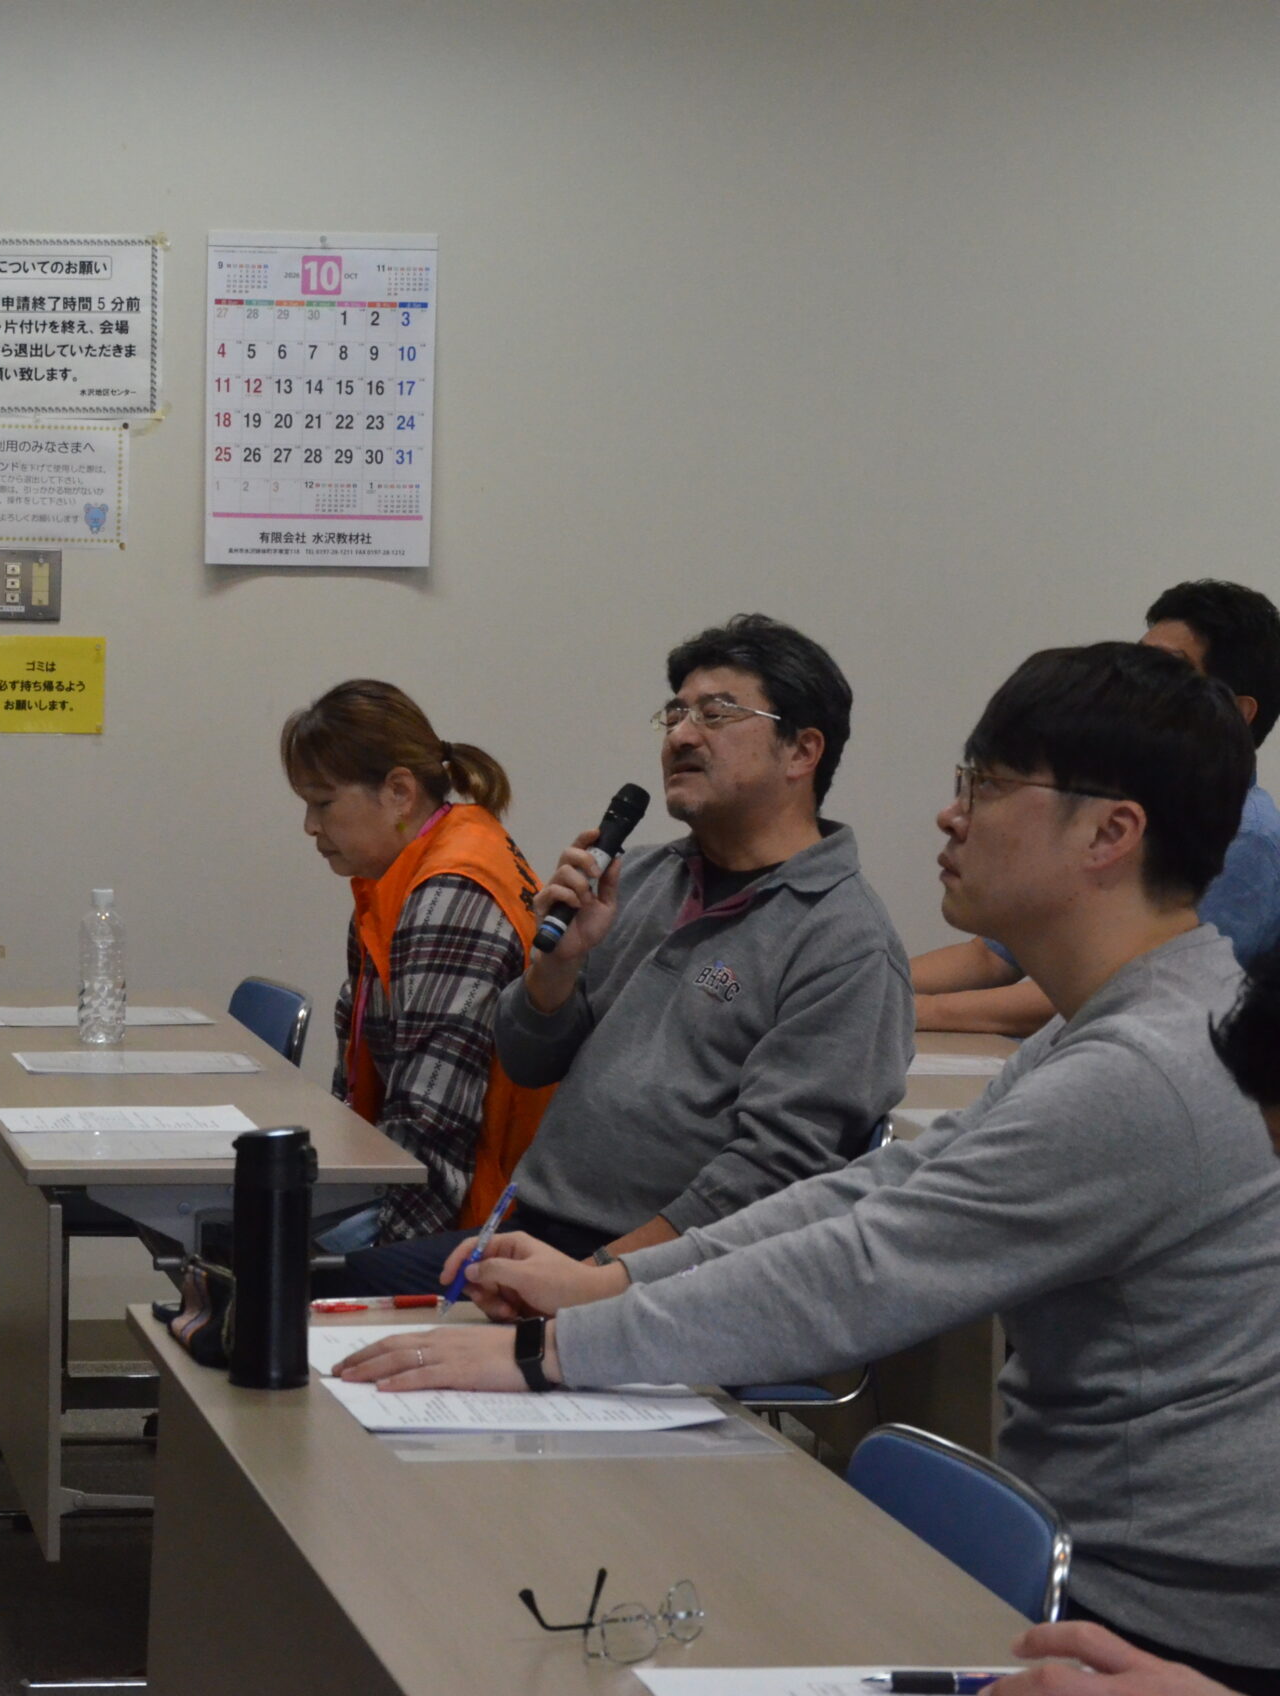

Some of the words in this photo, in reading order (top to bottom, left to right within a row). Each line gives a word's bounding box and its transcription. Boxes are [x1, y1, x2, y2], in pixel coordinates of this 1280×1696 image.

[218, 261, 223, 269] 9
[304, 260, 338, 292] 10
[344, 272, 358, 280] OCT
[216, 307, 229, 319] 27
[246, 308, 259, 319] 28
[277, 308, 290, 320] 29
[308, 309, 320, 320] 30
[341, 311, 346, 325] 1
[371, 311, 379, 326] 2
[402, 312, 410, 326] 3
[217, 343, 226, 357] 4
[248, 344, 256, 359] 5
[278, 344, 287, 359] 6
[309, 345, 317, 359] 7
[339, 345, 348, 360] 8
[370, 346, 379, 361] 9
[399, 346, 416, 361] 10
[216, 378, 230, 392] 11
[245, 378, 262, 393] 12
[275, 379, 292, 394] 13
[306, 380, 323, 394] 14
[337, 380, 353, 395] 15
[367, 380, 384, 395] 16
[398, 381, 415, 395] 17
[215, 412, 231, 427] 18
[244, 413, 261, 428] 19
[274, 413, 292, 428] 20
[305, 414, 321, 429] 21
[336, 415, 353, 429] 22
[366, 415, 384, 430] 23
[397, 415, 415, 430] 24
[215, 446, 231, 462] 25
[244, 447, 261, 462] 26
[274, 448, 292, 462] 27
[304, 448, 322, 463] 28
[335, 449, 353, 464] 29
[365, 449, 383, 464] 30
[396, 449, 412, 464] 31
[216, 480, 220, 491] 1
[243, 481, 249, 491] 2
[273, 481, 279, 492] 3
[260, 532, 306, 544] 有限会社
[312, 533, 371, 544] 水沢教材社
[26, 660, 56, 672] ゴミは
[4, 699, 73, 712] お願いします。
